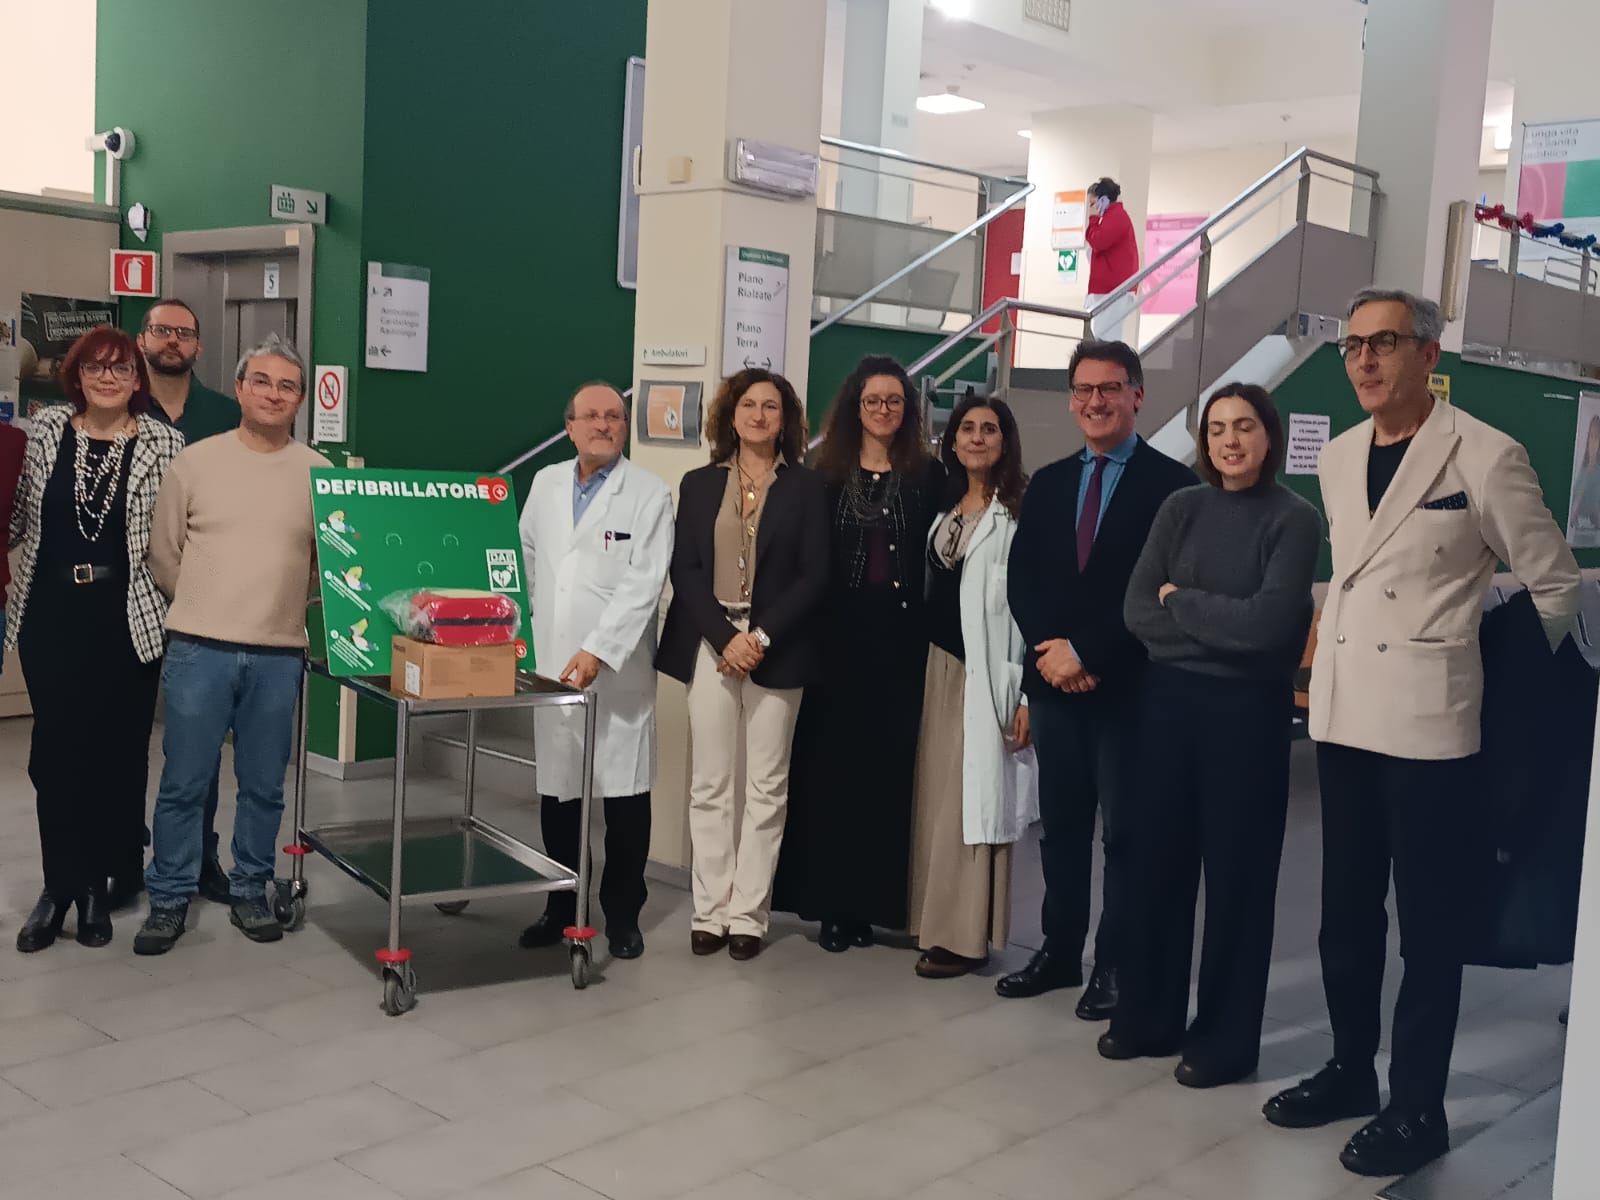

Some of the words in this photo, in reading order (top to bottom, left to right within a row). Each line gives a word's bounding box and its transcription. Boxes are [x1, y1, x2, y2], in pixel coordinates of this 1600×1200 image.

[738, 271, 764, 285] Piano
[737, 287, 773, 302] Rialzato
[736, 320, 762, 335] Piano
[736, 336, 759, 348] Terra
[315, 478, 491, 499] DEFIBRILLATORE
[490, 552, 514, 562] DAE
